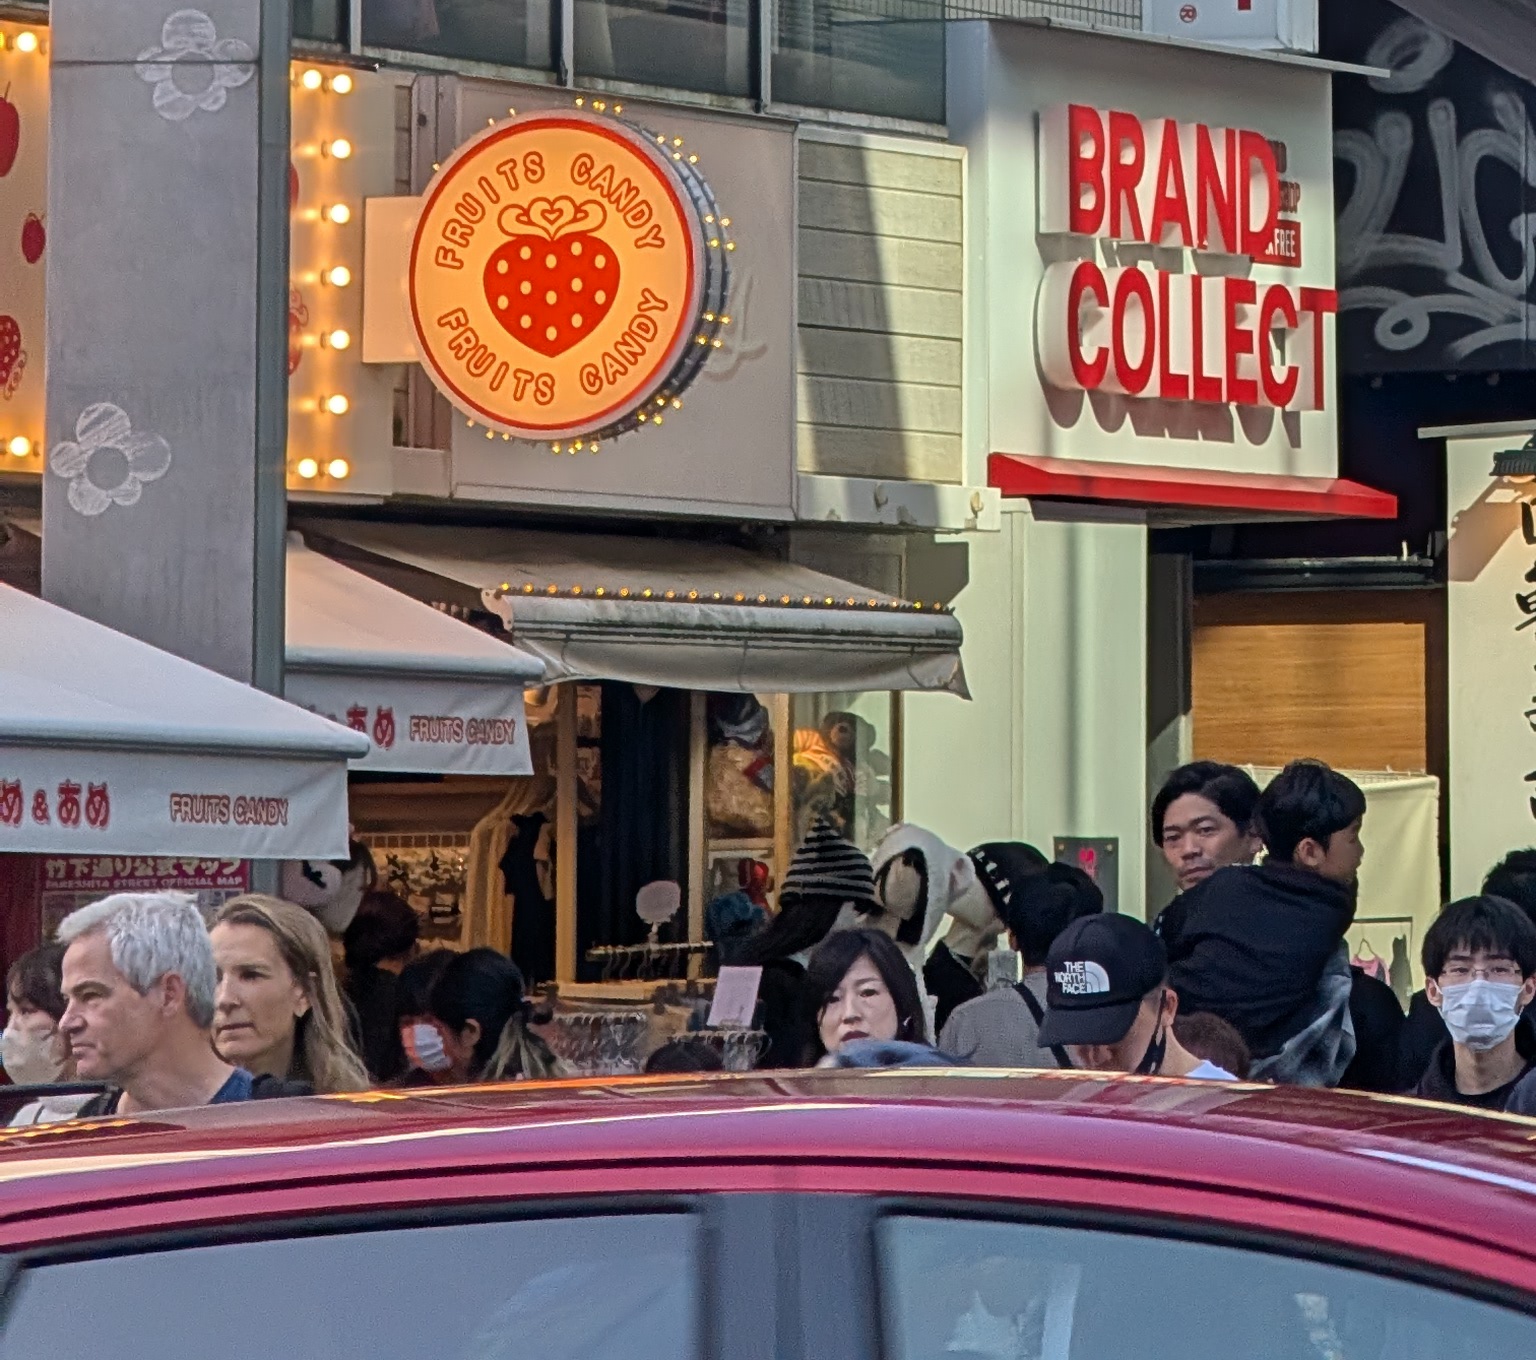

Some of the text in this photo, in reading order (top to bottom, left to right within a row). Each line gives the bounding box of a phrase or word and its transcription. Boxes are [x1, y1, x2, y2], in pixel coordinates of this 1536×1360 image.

[1066, 103, 1279, 256] BRAND
[435, 150, 667, 271] FRUITS CANDY
[437, 287, 669, 406] FRUITS CANDY
[1066, 260, 1338, 412] COLLECT
[409, 714, 464, 744] FRUITS
[465, 717, 516, 746] CANDY
[32, 788, 49, 825] &
[57, 778, 111, 829] あめ
[169, 792, 231, 824] FRUITS
[232, 795, 289, 827] CANDY
[1054, 971, 1086, 984] NORTH
[1062, 982, 1087, 995] FACE
[1063, 961, 1085, 973] THE
